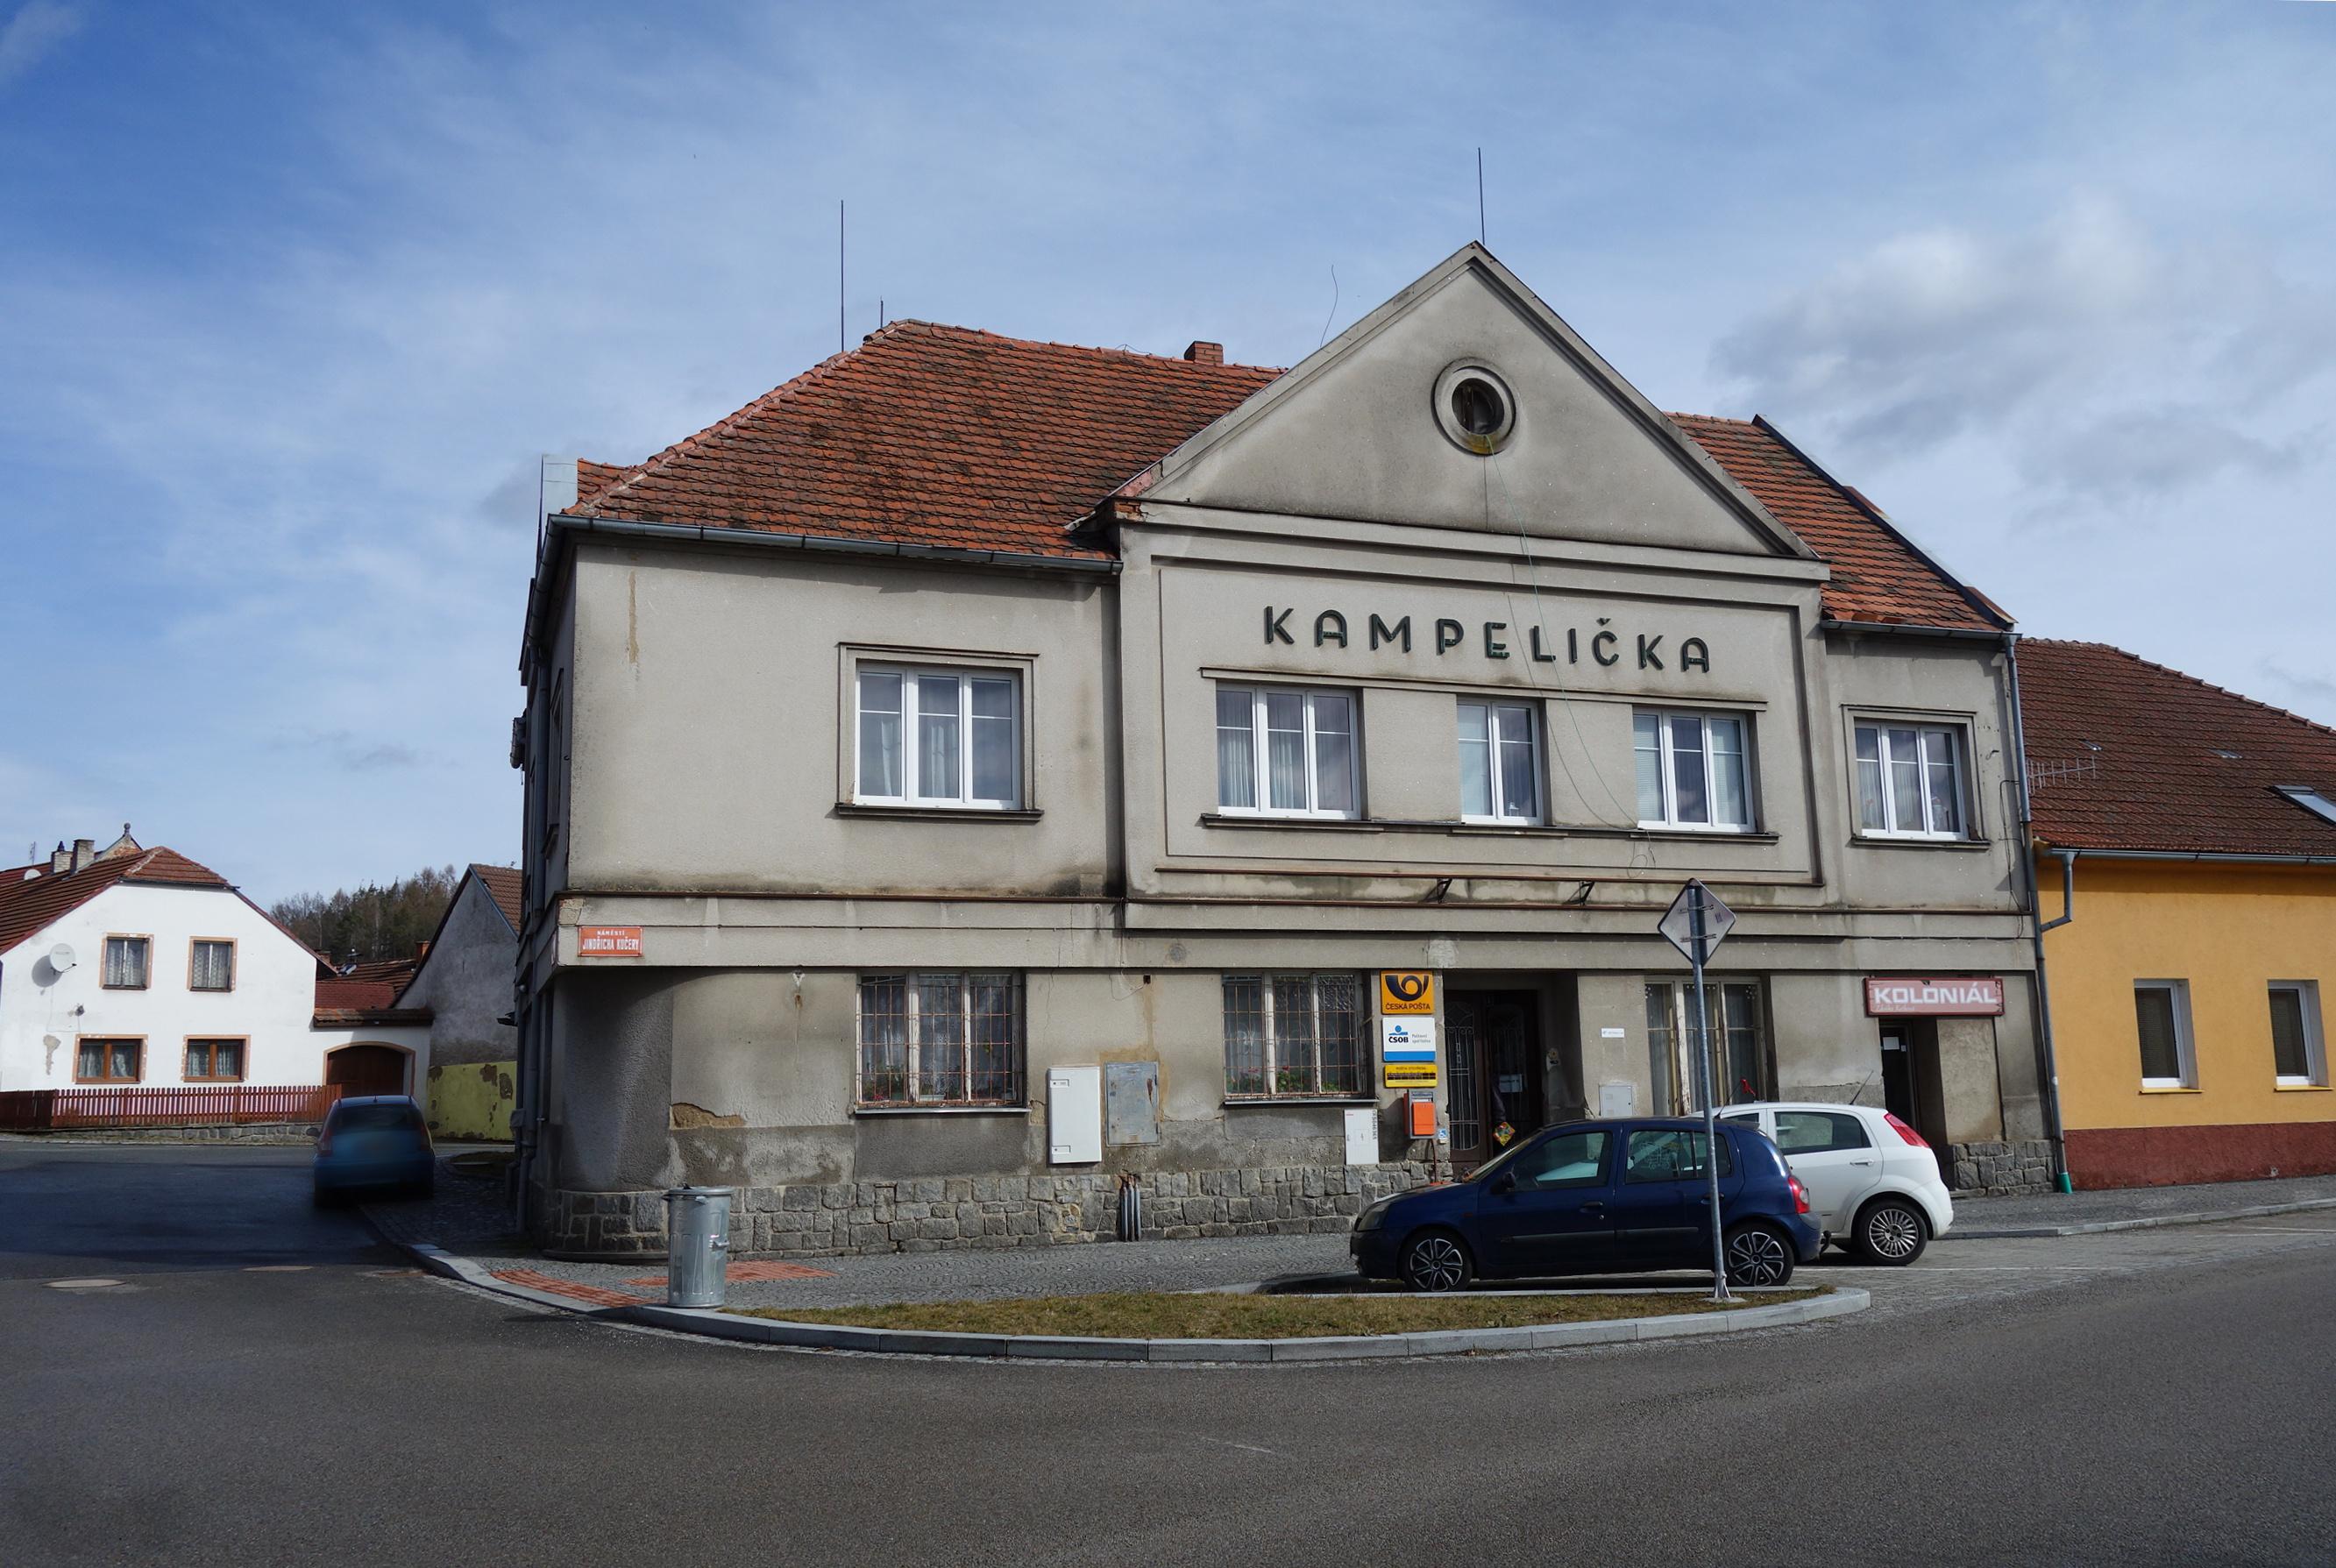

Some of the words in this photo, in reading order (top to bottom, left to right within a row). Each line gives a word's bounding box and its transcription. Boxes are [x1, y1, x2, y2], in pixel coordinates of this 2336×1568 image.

[1263, 605, 1710, 673] KAMPELIČKA
[582, 935, 614, 950] JINDŘICHA
[616, 936, 640, 951] KUČERY
[1873, 982, 1998, 1004] KOLONIÁL
[1385, 1002, 1409, 1011] ČESKÁ
[1409, 1002, 1431, 1011] POŠTA
